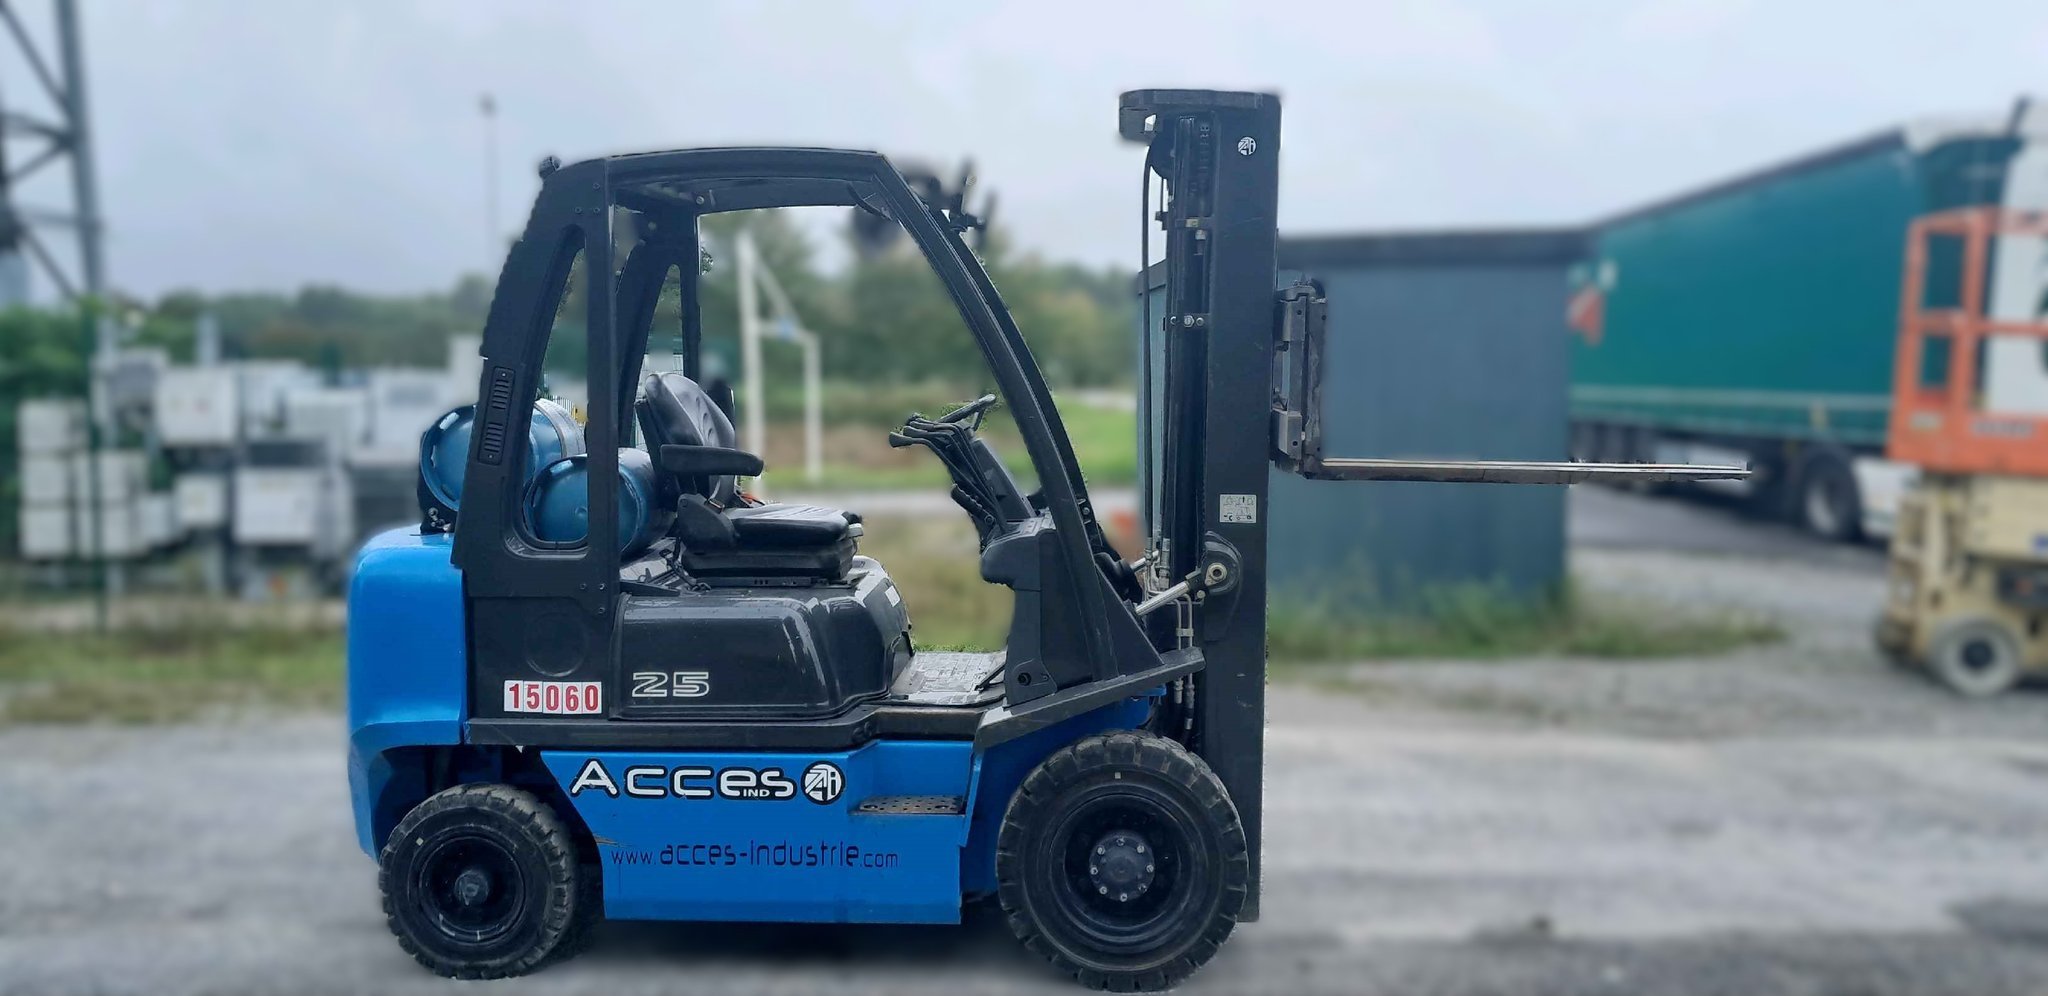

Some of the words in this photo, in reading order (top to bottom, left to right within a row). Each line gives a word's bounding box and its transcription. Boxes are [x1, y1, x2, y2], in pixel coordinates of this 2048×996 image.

[508, 684, 600, 712] 15060
[632, 672, 710, 697] 25
[571, 760, 796, 797] Acces
[743, 787, 771, 797] IND
[611, 840, 898, 868] www.acces-industrie.com
